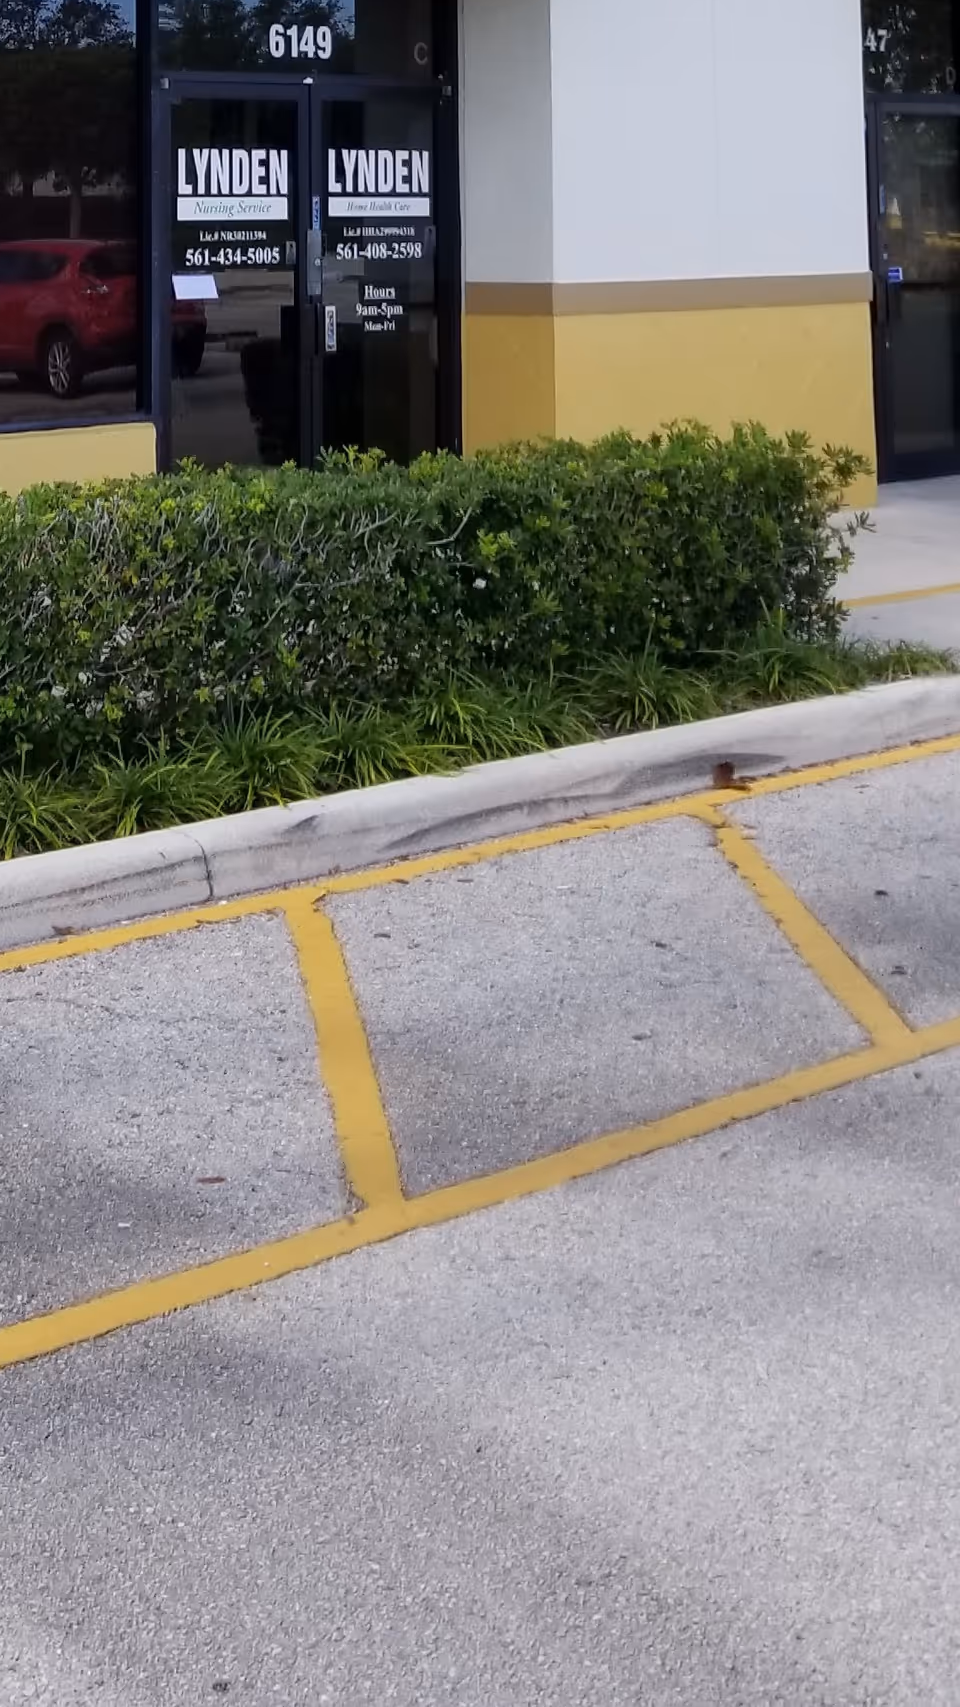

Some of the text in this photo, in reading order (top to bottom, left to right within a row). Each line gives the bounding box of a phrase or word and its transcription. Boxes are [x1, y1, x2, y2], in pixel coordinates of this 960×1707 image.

[268, 23, 333, 60] 6149
[176, 147, 289, 196] LYNDEN
[327, 148, 430, 194] LYNDEN
[194, 199, 272, 218] Nursing Service
[369, 201, 393, 212] Health
[394, 201, 411, 212] Care
[185, 247, 281, 266] 561-434-5005
[336, 242, 422, 260] 561-408-2598
[364, 285, 396, 299] Hours
[355, 302, 404, 319] 9am-5pm
